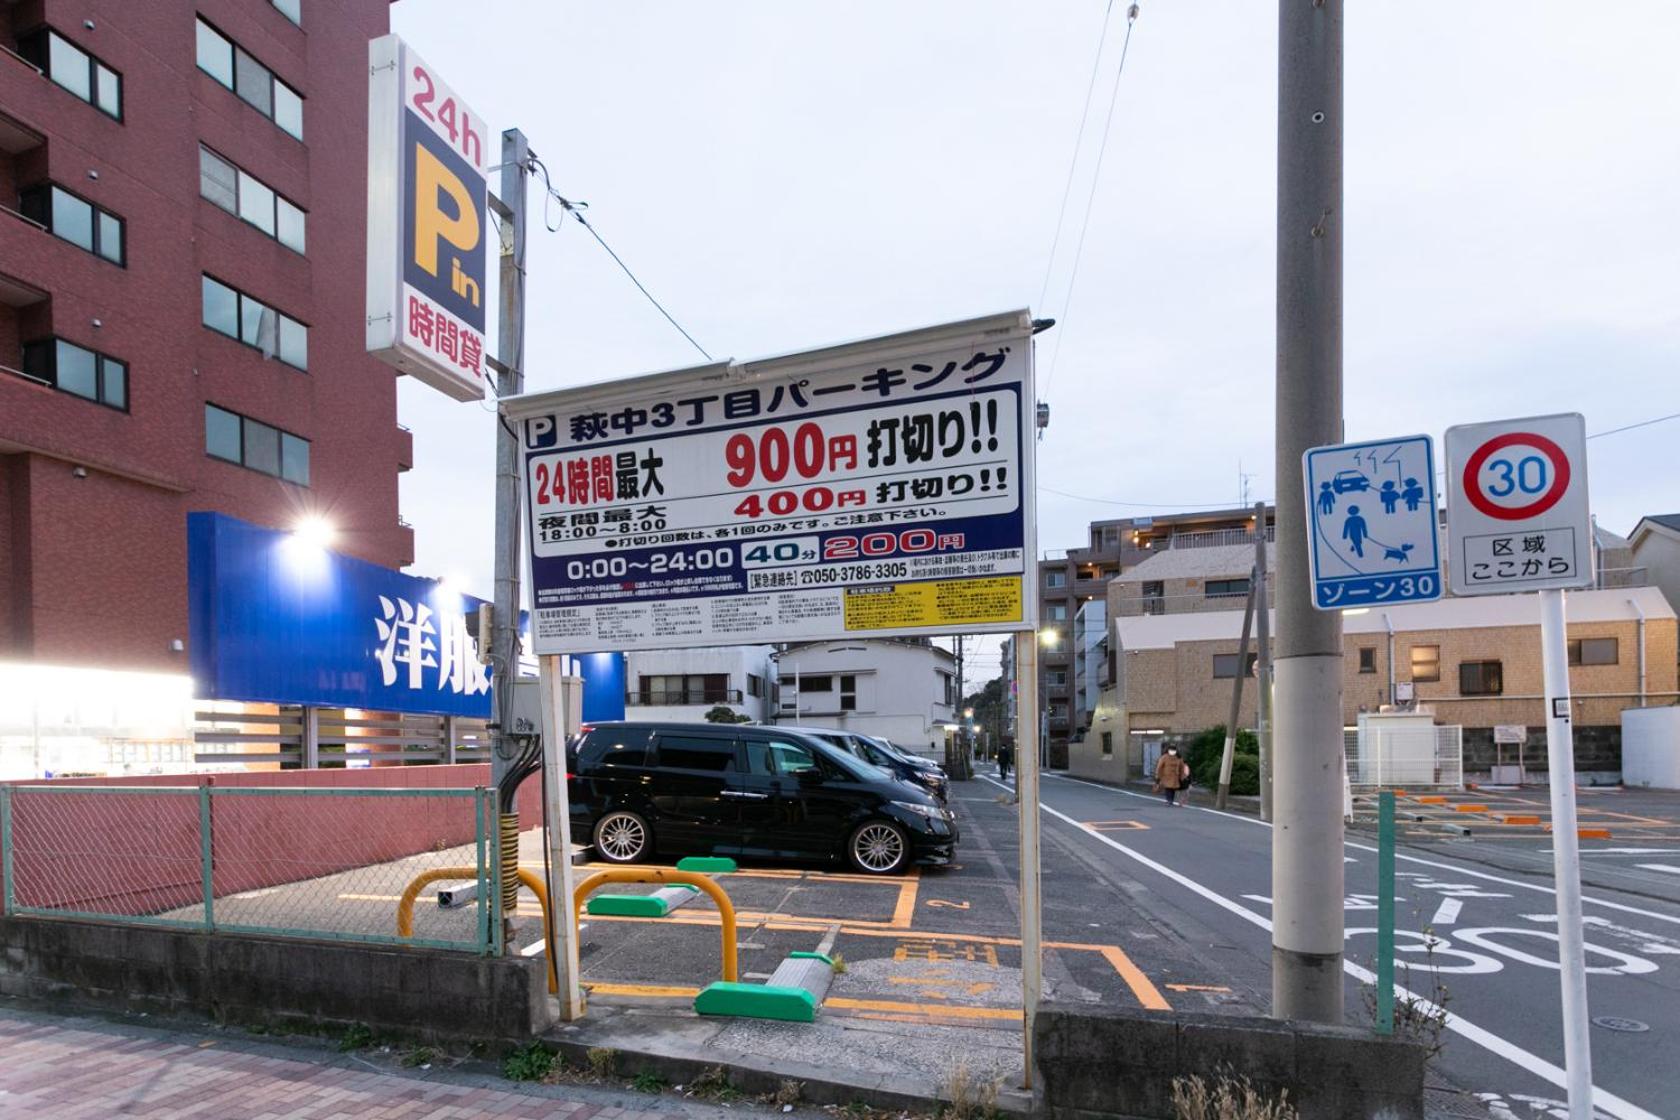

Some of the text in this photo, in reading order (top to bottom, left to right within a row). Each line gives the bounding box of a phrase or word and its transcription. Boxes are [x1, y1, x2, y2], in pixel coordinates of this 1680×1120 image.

[413, 66, 481, 167] 24h
[409, 295, 482, 378] 時間貸
[569, 346, 1011, 443] 萩中3丁目パーキング
[536, 447, 664, 505] 24時間最大
[725, 421, 858, 488] 900円
[1488, 456, 1547, 497] 30
[538, 505, 667, 529] 夜間最大
[733, 487, 866, 518] 400円
[744, 543, 816, 563] 40分
[824, 528, 966, 560] 200円
[1493, 535, 1547, 556] 区域
[1472, 556, 1570, 580] ここから
[1323, 576, 1435, 605] ゾーン30
